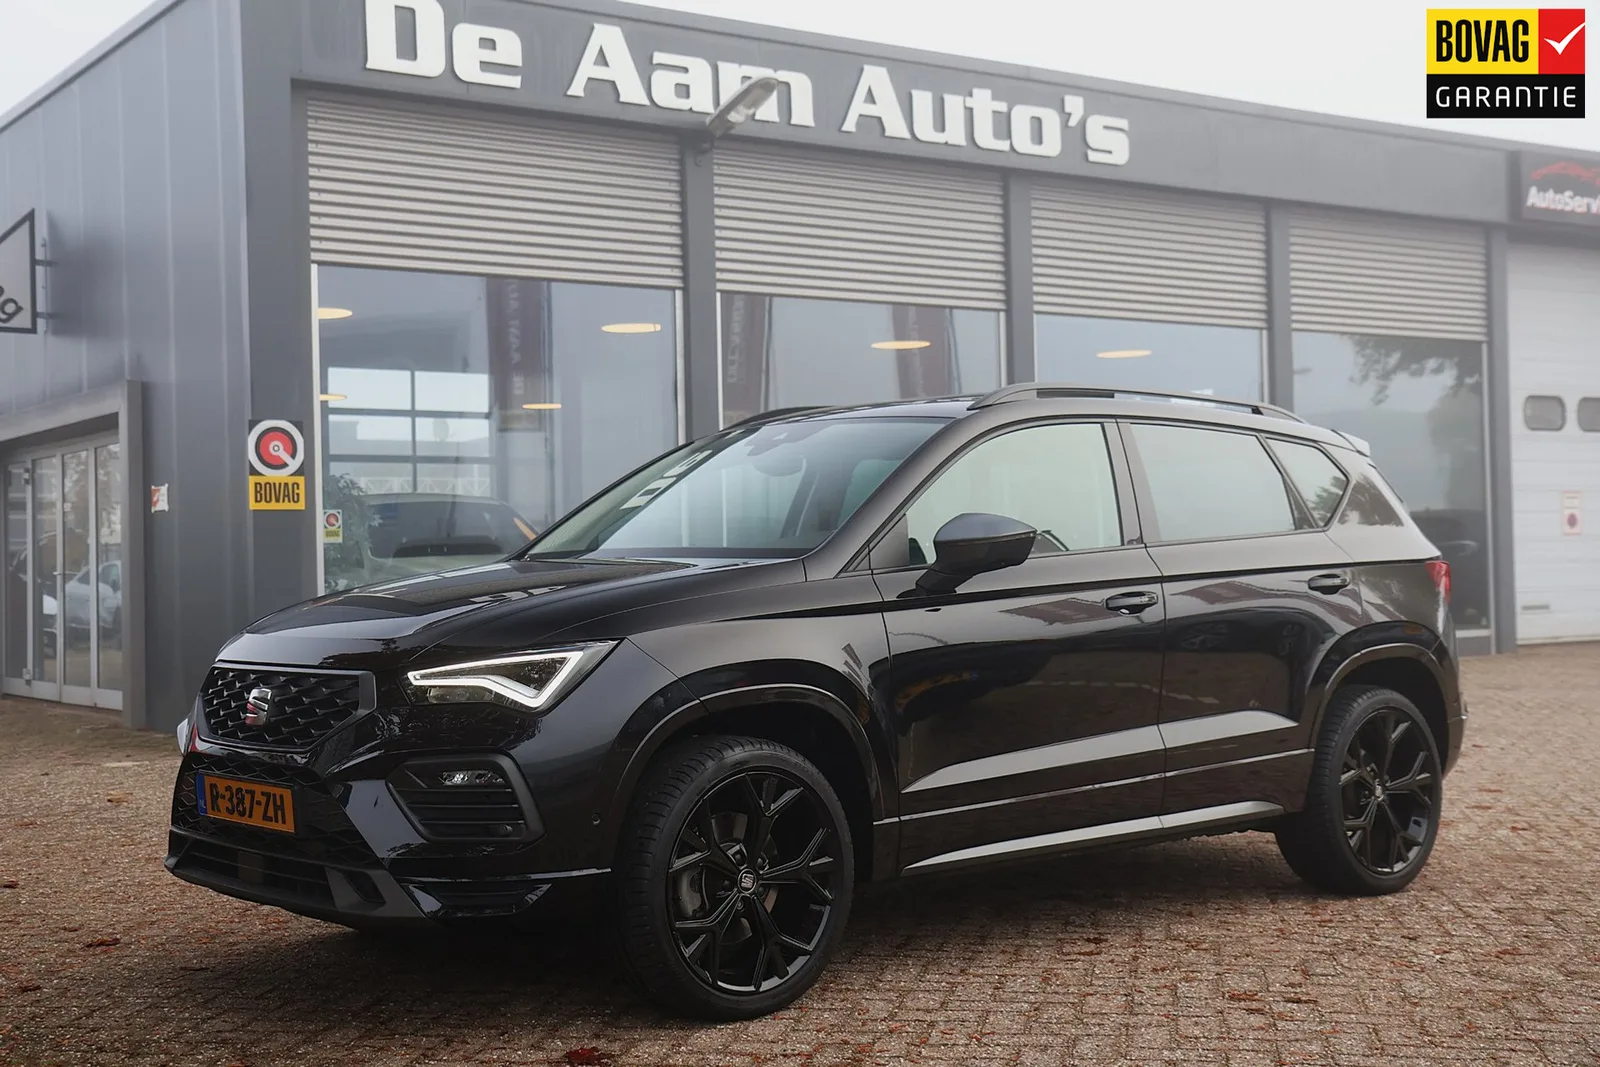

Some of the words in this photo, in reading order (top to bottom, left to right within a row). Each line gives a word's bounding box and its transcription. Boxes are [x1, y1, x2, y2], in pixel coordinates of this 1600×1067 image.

[365, 0, 523, 89] De
[566, 23, 815, 128] Aam
[840, 64, 1131, 166] Auto's
[254, 482, 300, 504] BOVAG
[209, 783, 286, 825] R-387-ZH
